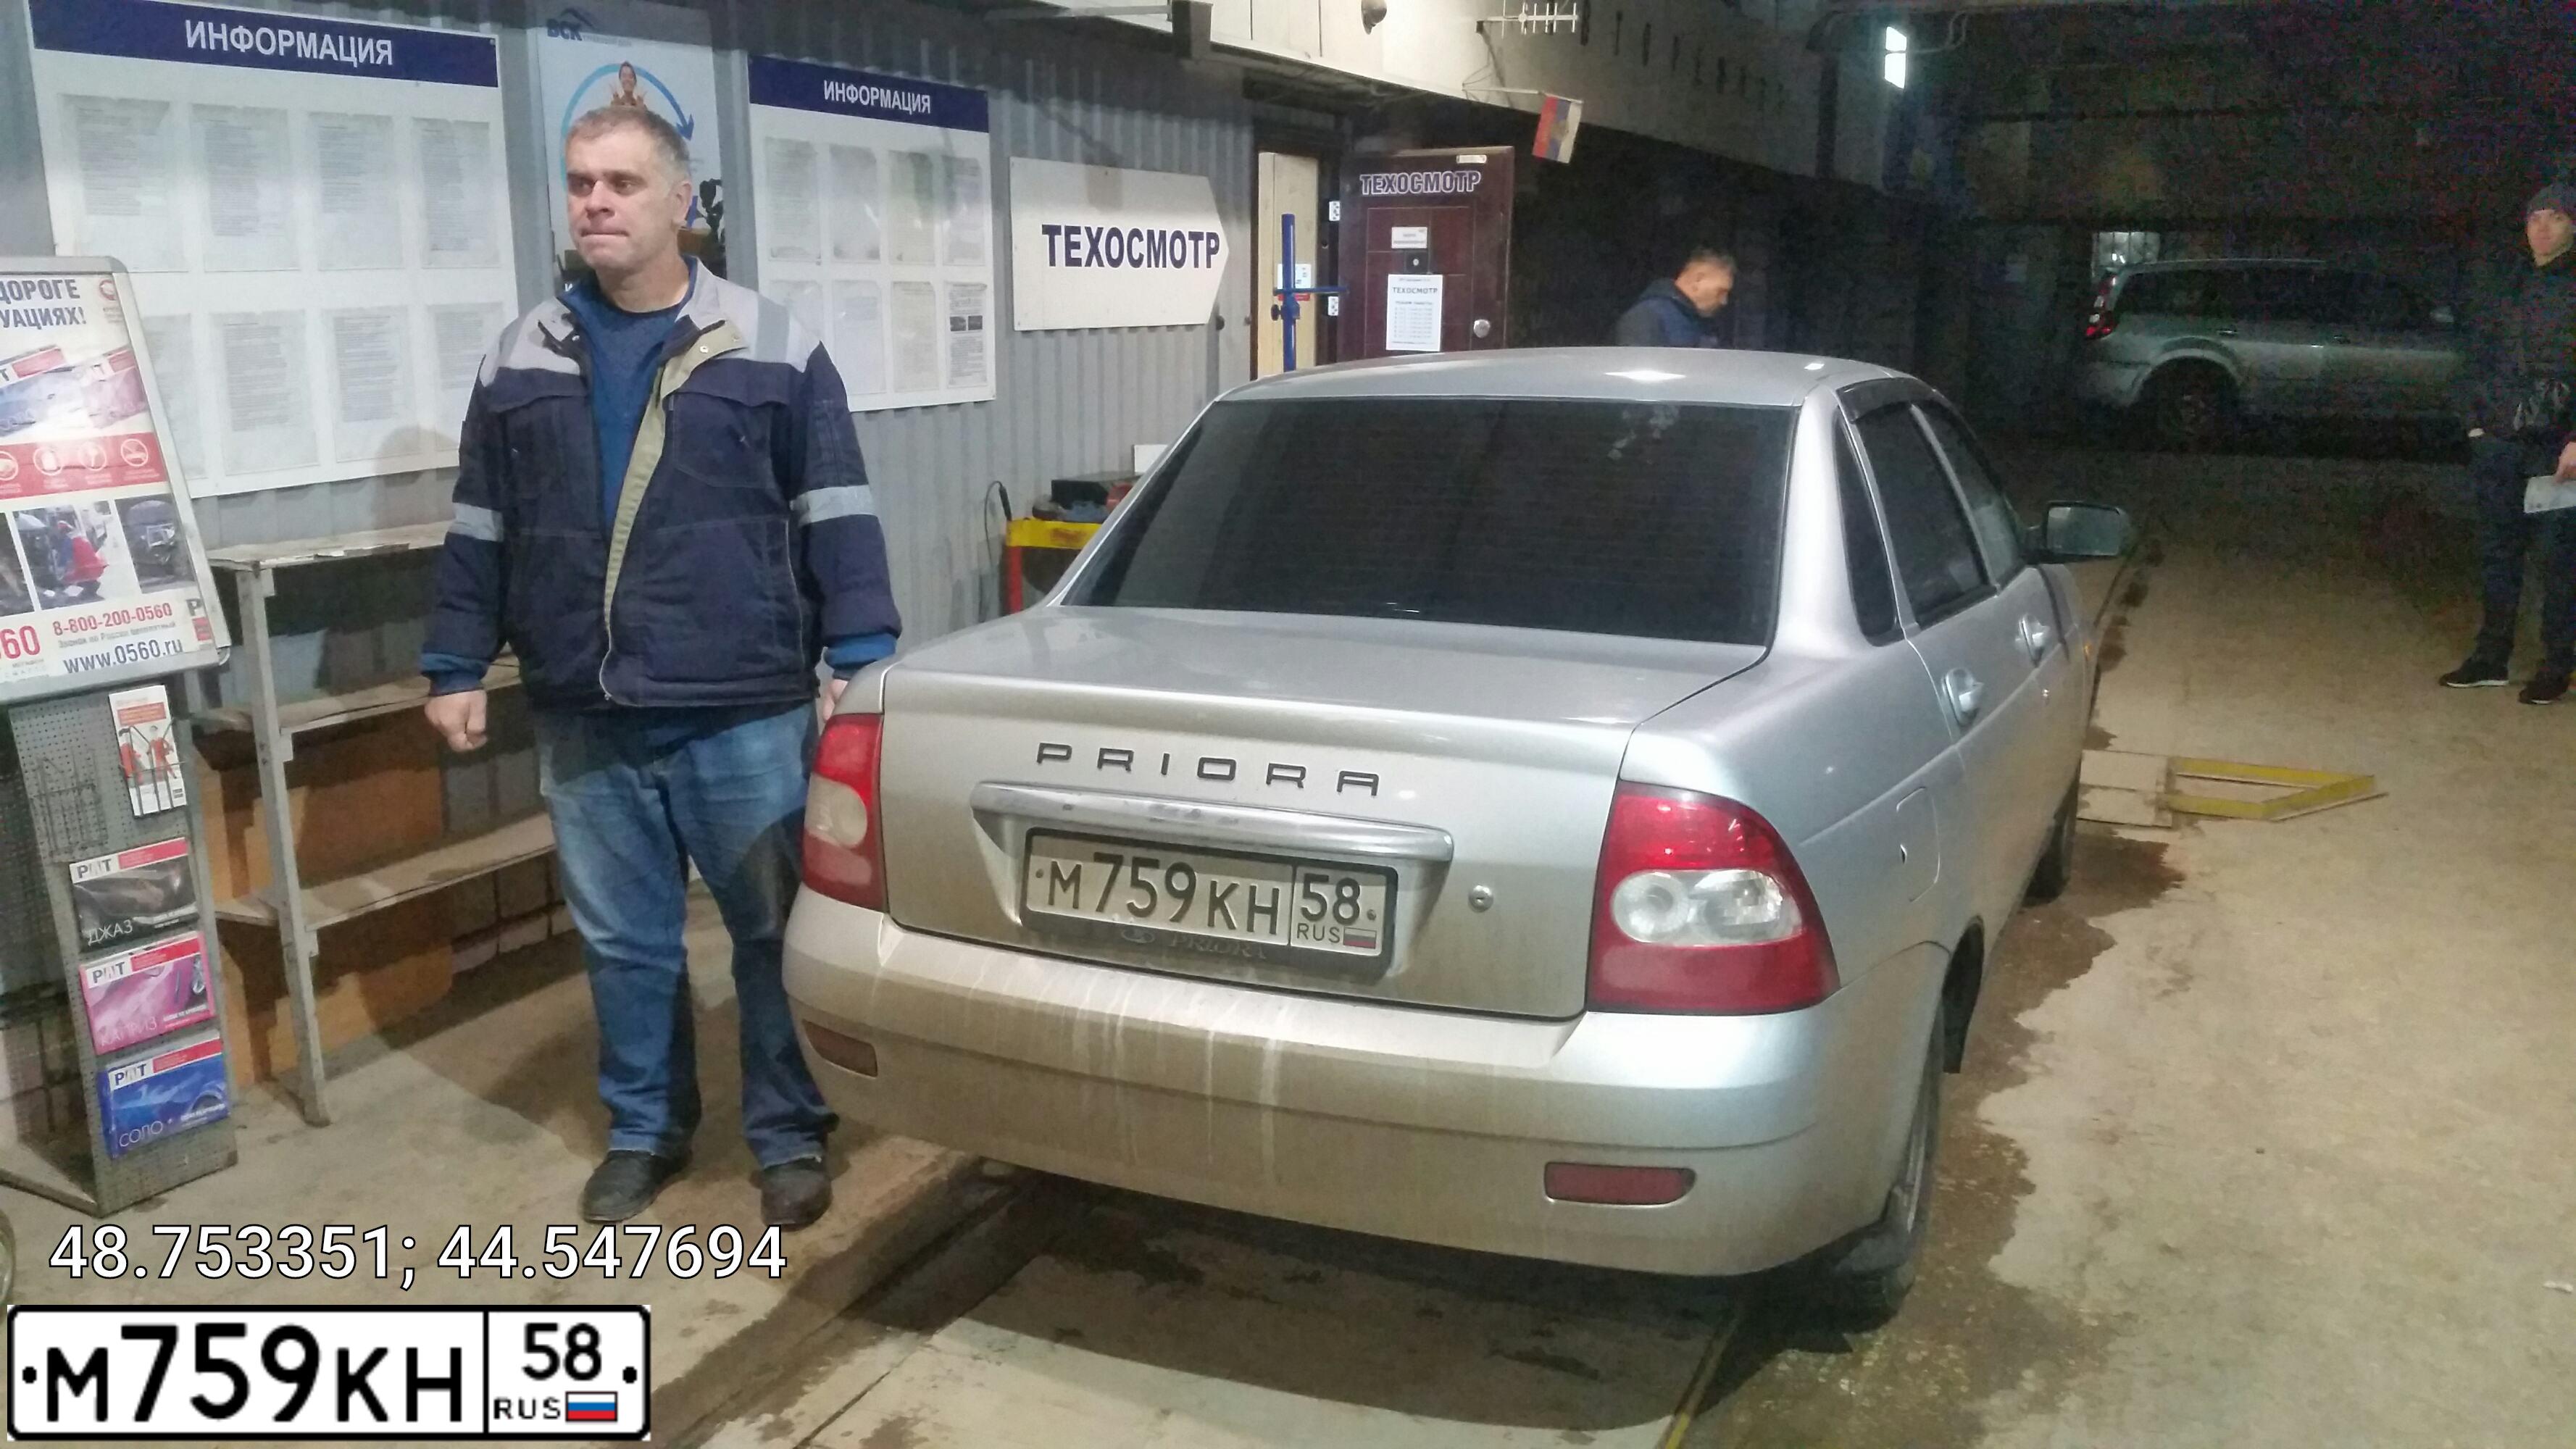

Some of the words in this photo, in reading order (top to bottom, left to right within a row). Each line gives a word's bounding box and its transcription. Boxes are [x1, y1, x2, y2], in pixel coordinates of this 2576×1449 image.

[186, 20, 393, 67] ИНФОРМАЦИЯ
[823, 79, 931, 114] ИНФОРМАЦИЯ
[1360, 171, 1481, 196] ТЕХОСМОТР
[1041, 224, 1220, 270] ТЕХОСМОТР
[52, 603, 172, 636] 8-800-200-0560
[0, 625, 41, 661] 60
[63, 638, 183, 674] www.0560.ru
[1035, 742, 1380, 798] PRIORA
[1047, 851, 1280, 936] М759КН
[1300, 872, 1362, 927] 58
[88, 919, 133, 947] ДЖАЗ
[1296, 922, 1341, 945] RUS
[119, 1120, 163, 1147] СОЛО
